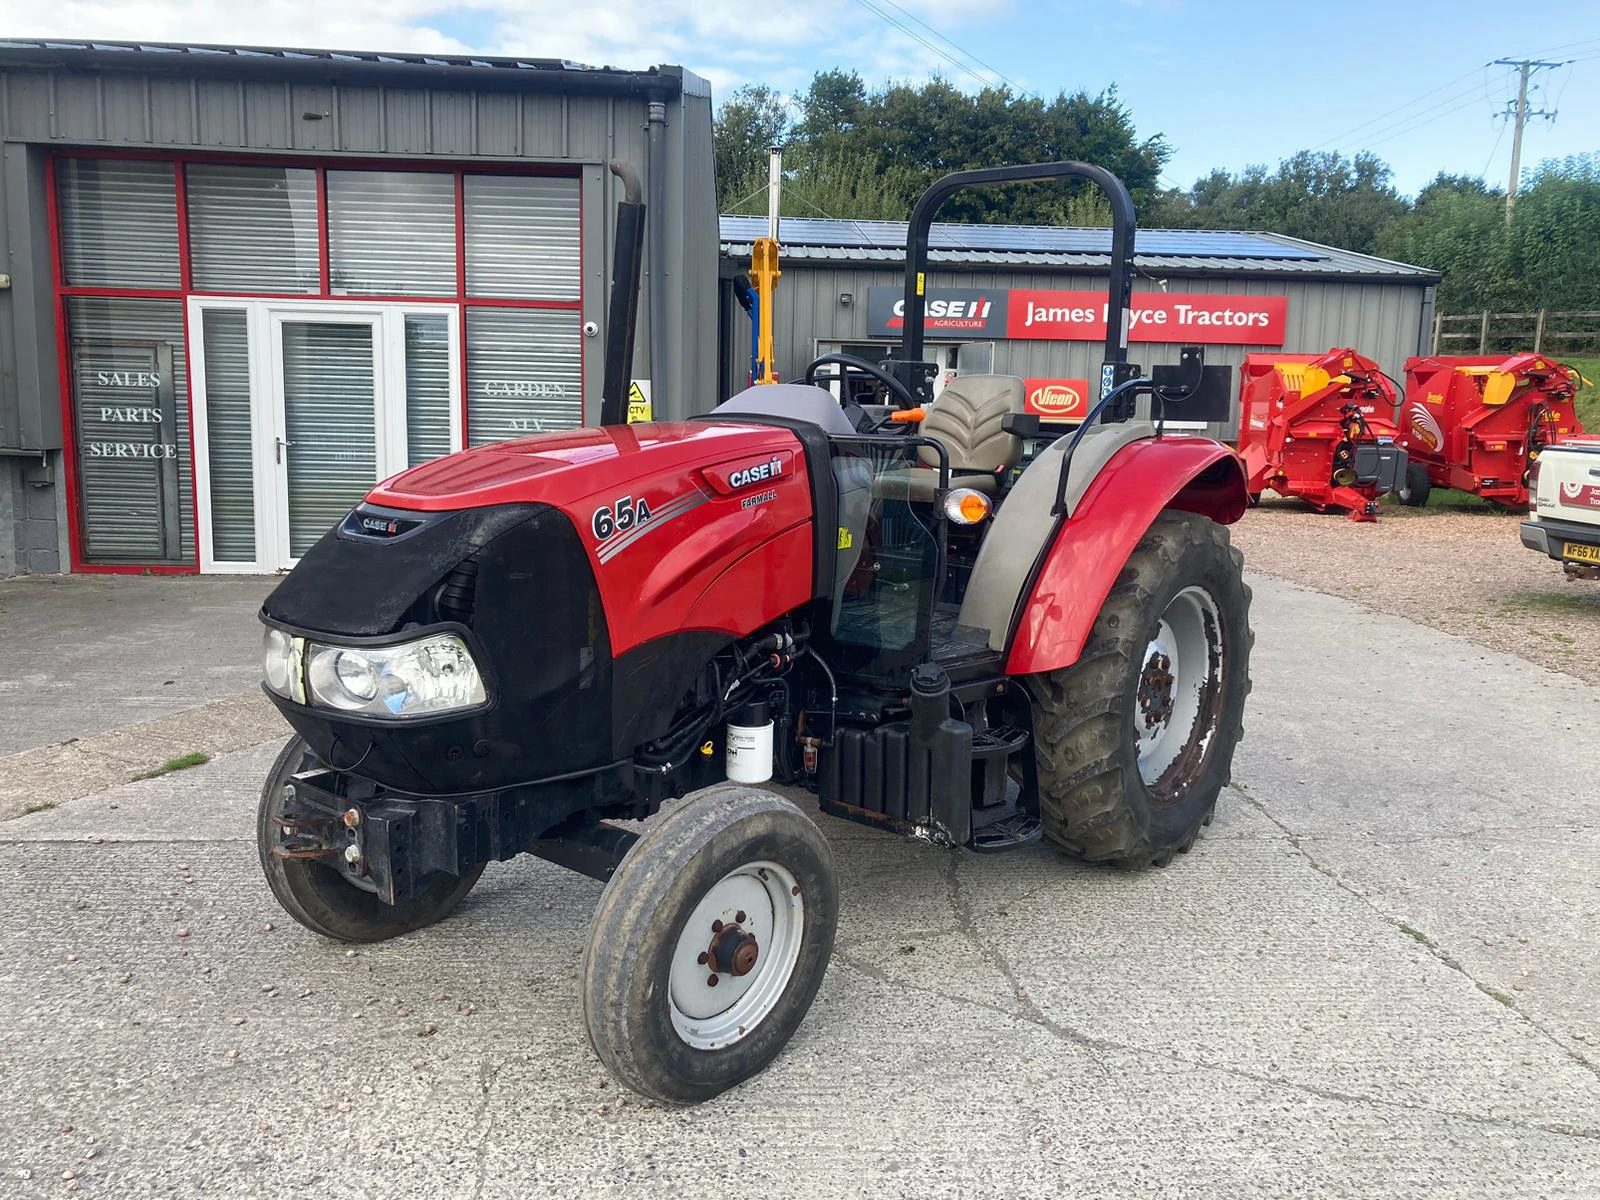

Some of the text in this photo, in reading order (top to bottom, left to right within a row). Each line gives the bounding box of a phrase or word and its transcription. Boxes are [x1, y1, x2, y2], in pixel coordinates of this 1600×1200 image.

[1025, 301, 1095, 327] James
[1174, 304, 1269, 327] Tractors
[933, 320, 983, 328] AGRICULTURE
[98, 371, 160, 387] SALES
[484, 381, 566, 397] GARDEN
[100, 407, 162, 423] PARTS
[629, 406, 645, 414] CTV
[508, 416, 545, 432] ATV
[90, 441, 177, 458] SERVICE
[730, 464, 769, 488] CASE
[741, 489, 777, 510] FARMALL
[363, 519, 387, 530] CASE
[591, 494, 653, 541] 65A
[1567, 543, 1588, 557] WF66
